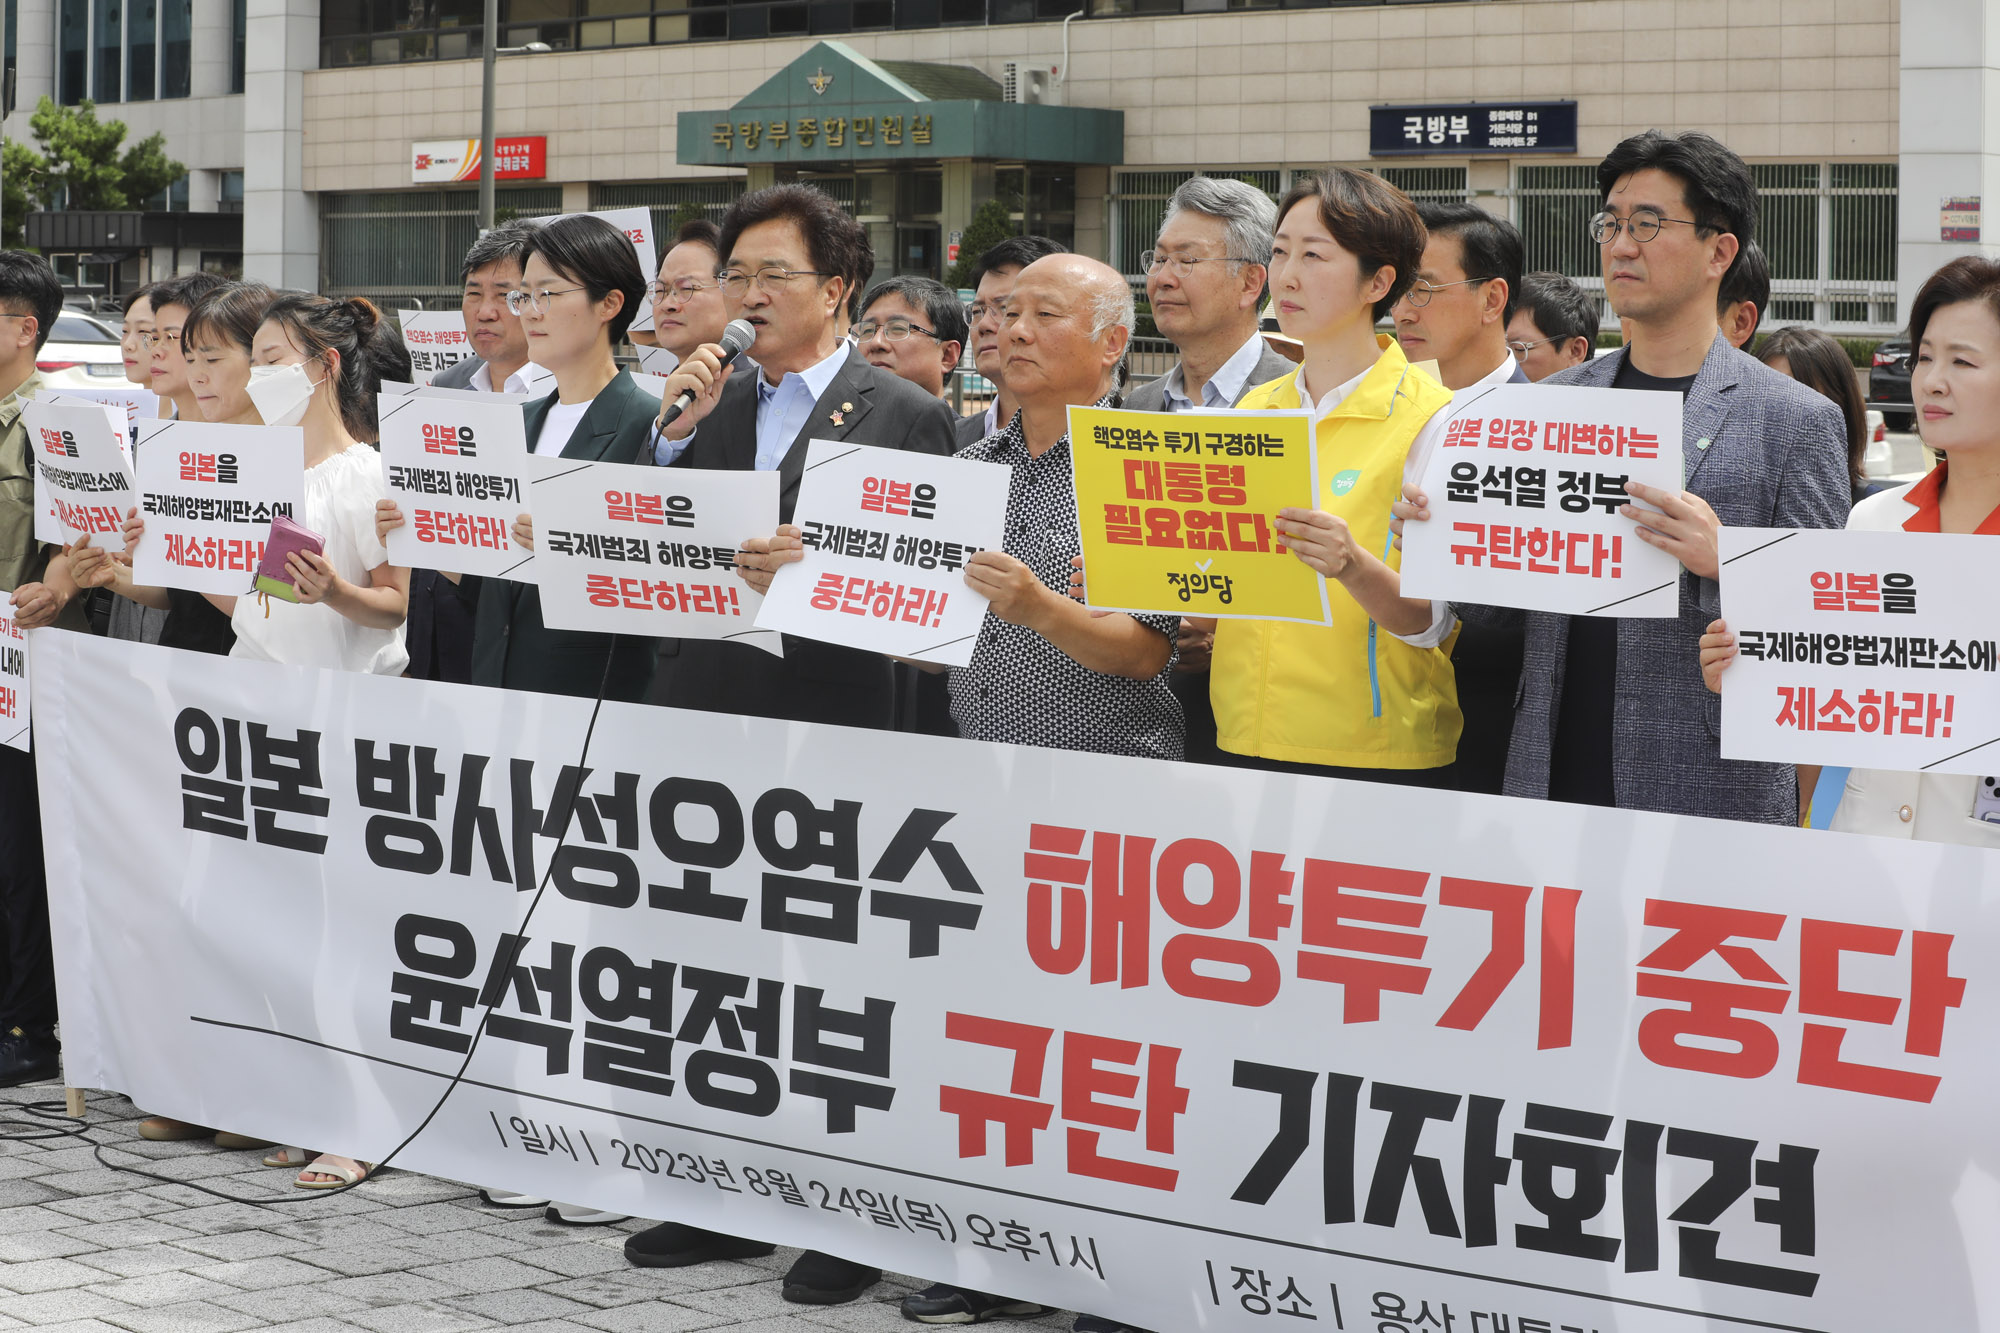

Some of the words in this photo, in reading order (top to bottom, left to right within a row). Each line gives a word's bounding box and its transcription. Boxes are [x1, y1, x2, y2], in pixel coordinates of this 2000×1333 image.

[711, 114, 932, 150] 국방부종합민원실
[1403, 115, 1469, 144] 국방부
[1488, 111, 1523, 121] 종합매장
[1527, 112, 1537, 121] B1
[1488, 124, 1523, 134] 가든식당
[1527, 125, 1537, 134] B1
[1527, 137, 1537, 146] 2F
[494, 156, 529, 171] 편취급국
[411, 350, 432, 371] 일본
[40, 427, 79, 458] 일본을
[422, 423, 477, 457] 일본은
[1093, 425, 1159, 452] 핵오염수
[1163, 431, 1200, 455] 투기
[1204, 432, 1284, 457] 구경하는
[1442, 418, 1483, 448] 일본
[1487, 418, 1538, 452] 입장
[1544, 421, 1659, 459] 대변하는
[179, 451, 238, 484] 일본을
[389, 465, 452, 496] 국제범죄
[455, 471, 521, 504] 해양투기
[1123, 459, 1247, 506] 대통령
[1446, 461, 1547, 509] 윤석열
[1557, 470, 1631, 514] 정부
[143, 493, 292, 524] 국제해양법재판소에
[604, 490, 695, 528] 일본은
[860, 476, 936, 520] 일본은
[414, 509, 509, 551] 중단하라!
[548, 529, 651, 564] 국제범죄
[656, 541, 760, 571] 해양투
[801, 520, 890, 561] 국제범죄
[1450, 521, 1623, 579] 규탄한다!
[164, 533, 264, 573] 제소하라!
[585, 573, 741, 616] 중단하라!
[810, 572, 948, 628] 중단하라!
[1167, 572, 1233, 604] 정의당
[1810, 571, 1917, 614] 일본을
[2, 646, 25, 678] 내에
[1738, 630, 1997, 672] 국제해양법재판소에
[1775, 686, 1955, 738] 제소하라!
[174, 706, 330, 855] 일본
[354, 738, 985, 959] 방사성오염수
[1023, 823, 1584, 1051] 해양투기
[1636, 898, 1967, 1104] 중단
[390, 913, 896, 1134] 윤석열정부
[939, 1011, 1190, 1193] 규탄
[1230, 1059, 1821, 1298] 기자회견
[610, 1138, 743, 1194] 2023년
[742, 1166, 809, 1208] 8월
[808, 1180, 957, 1244] 24일(목)
[966, 1213, 1105, 1281] 오후1시
